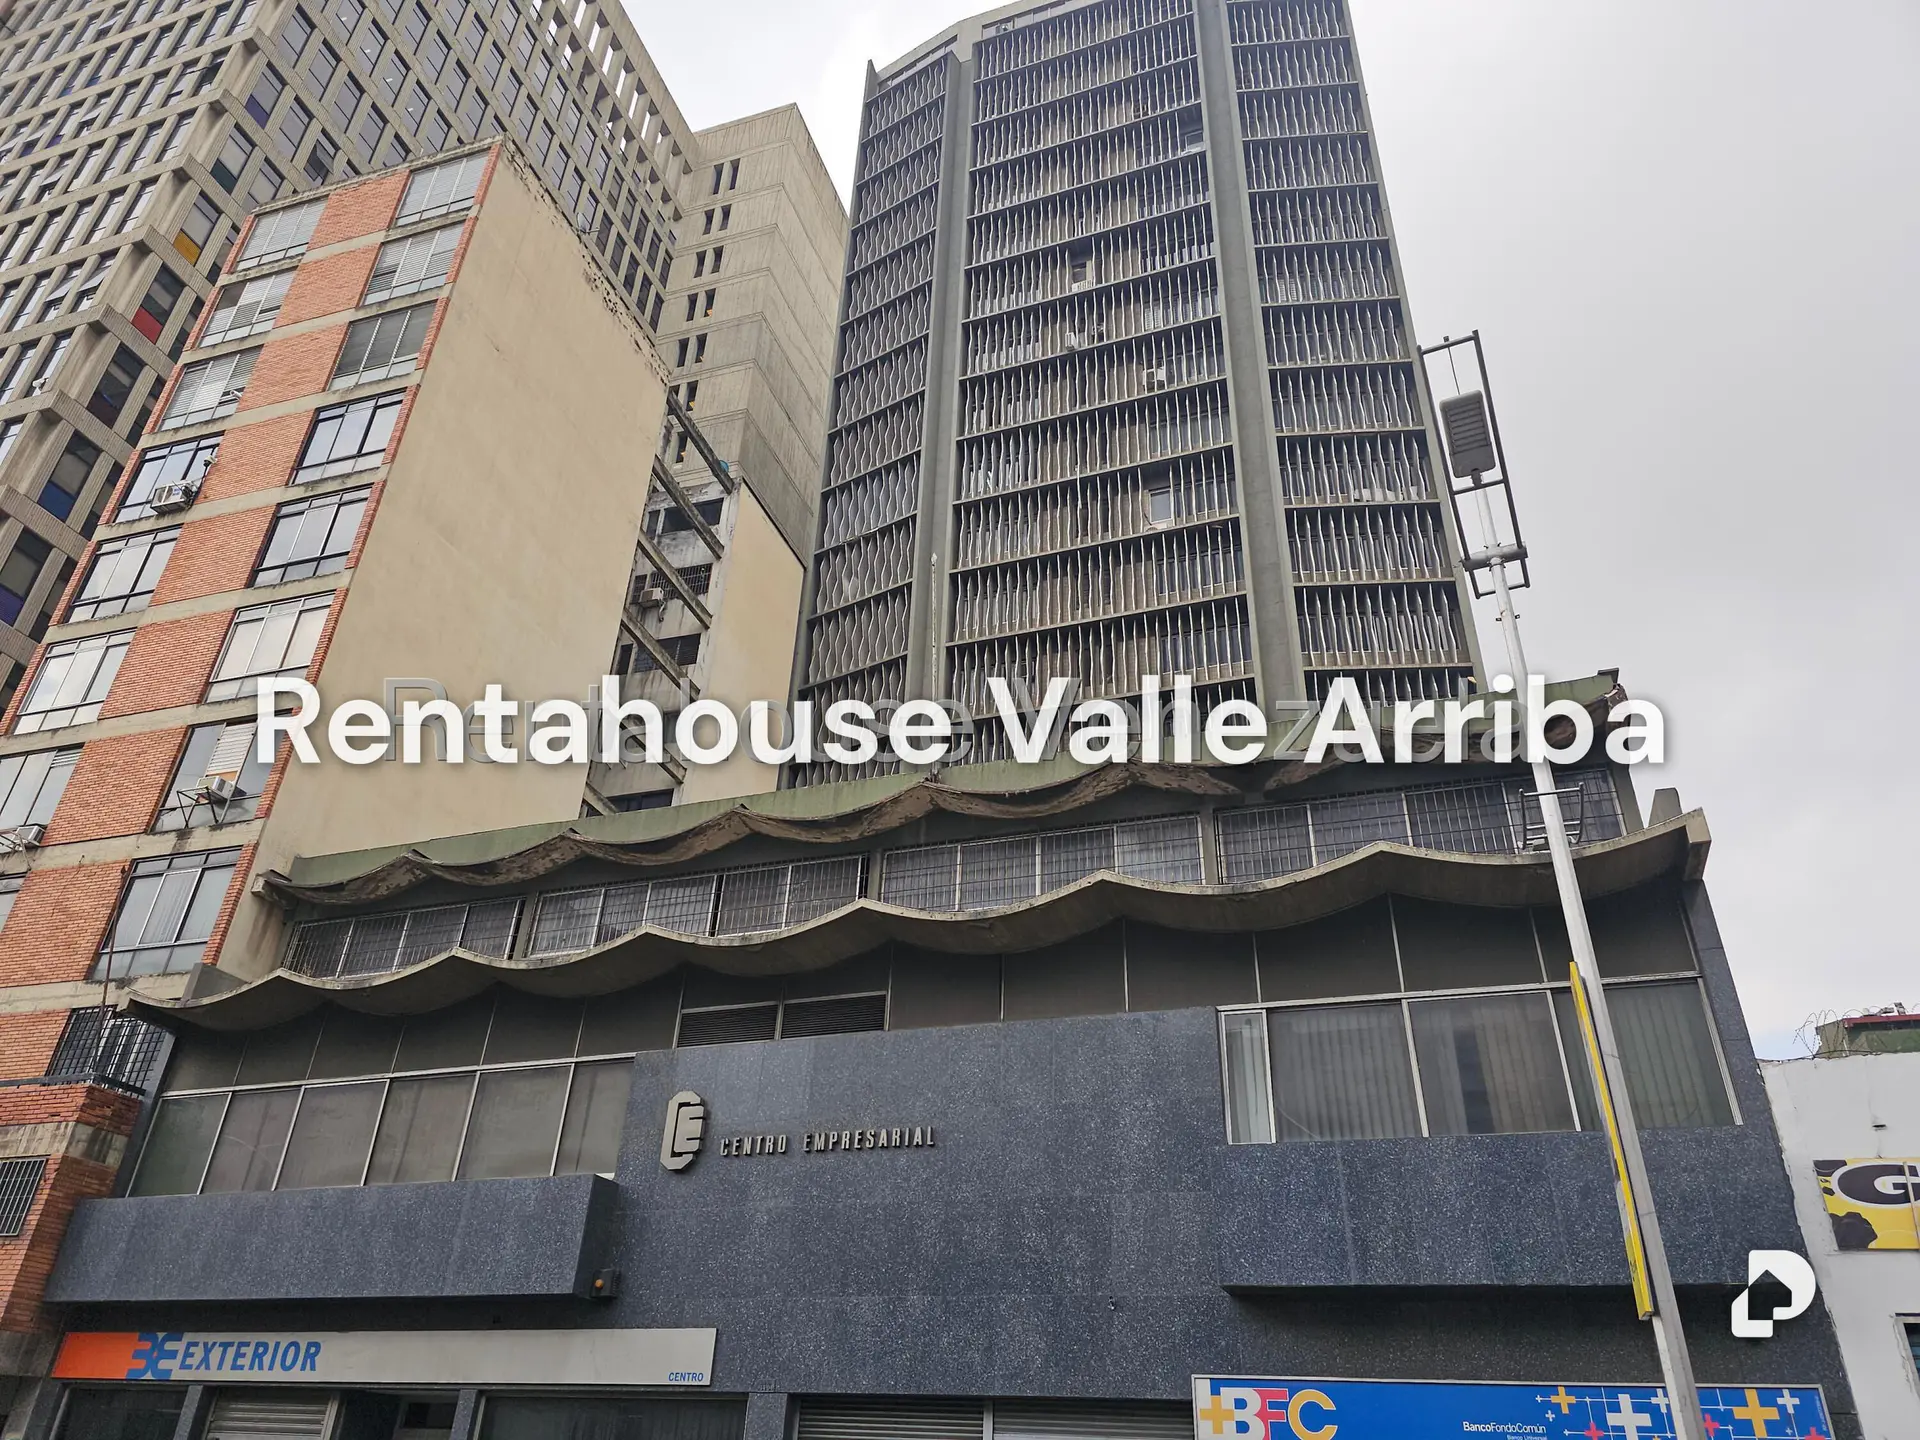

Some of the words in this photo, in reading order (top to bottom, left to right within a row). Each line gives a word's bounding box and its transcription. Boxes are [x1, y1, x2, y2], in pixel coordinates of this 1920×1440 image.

[720, 1135, 787, 1156] CENTRO
[803, 1126, 936, 1152] EMPRESARIAL
[179, 1341, 322, 1372] EXTERIOR
[668, 1372, 704, 1381] CENTRO
